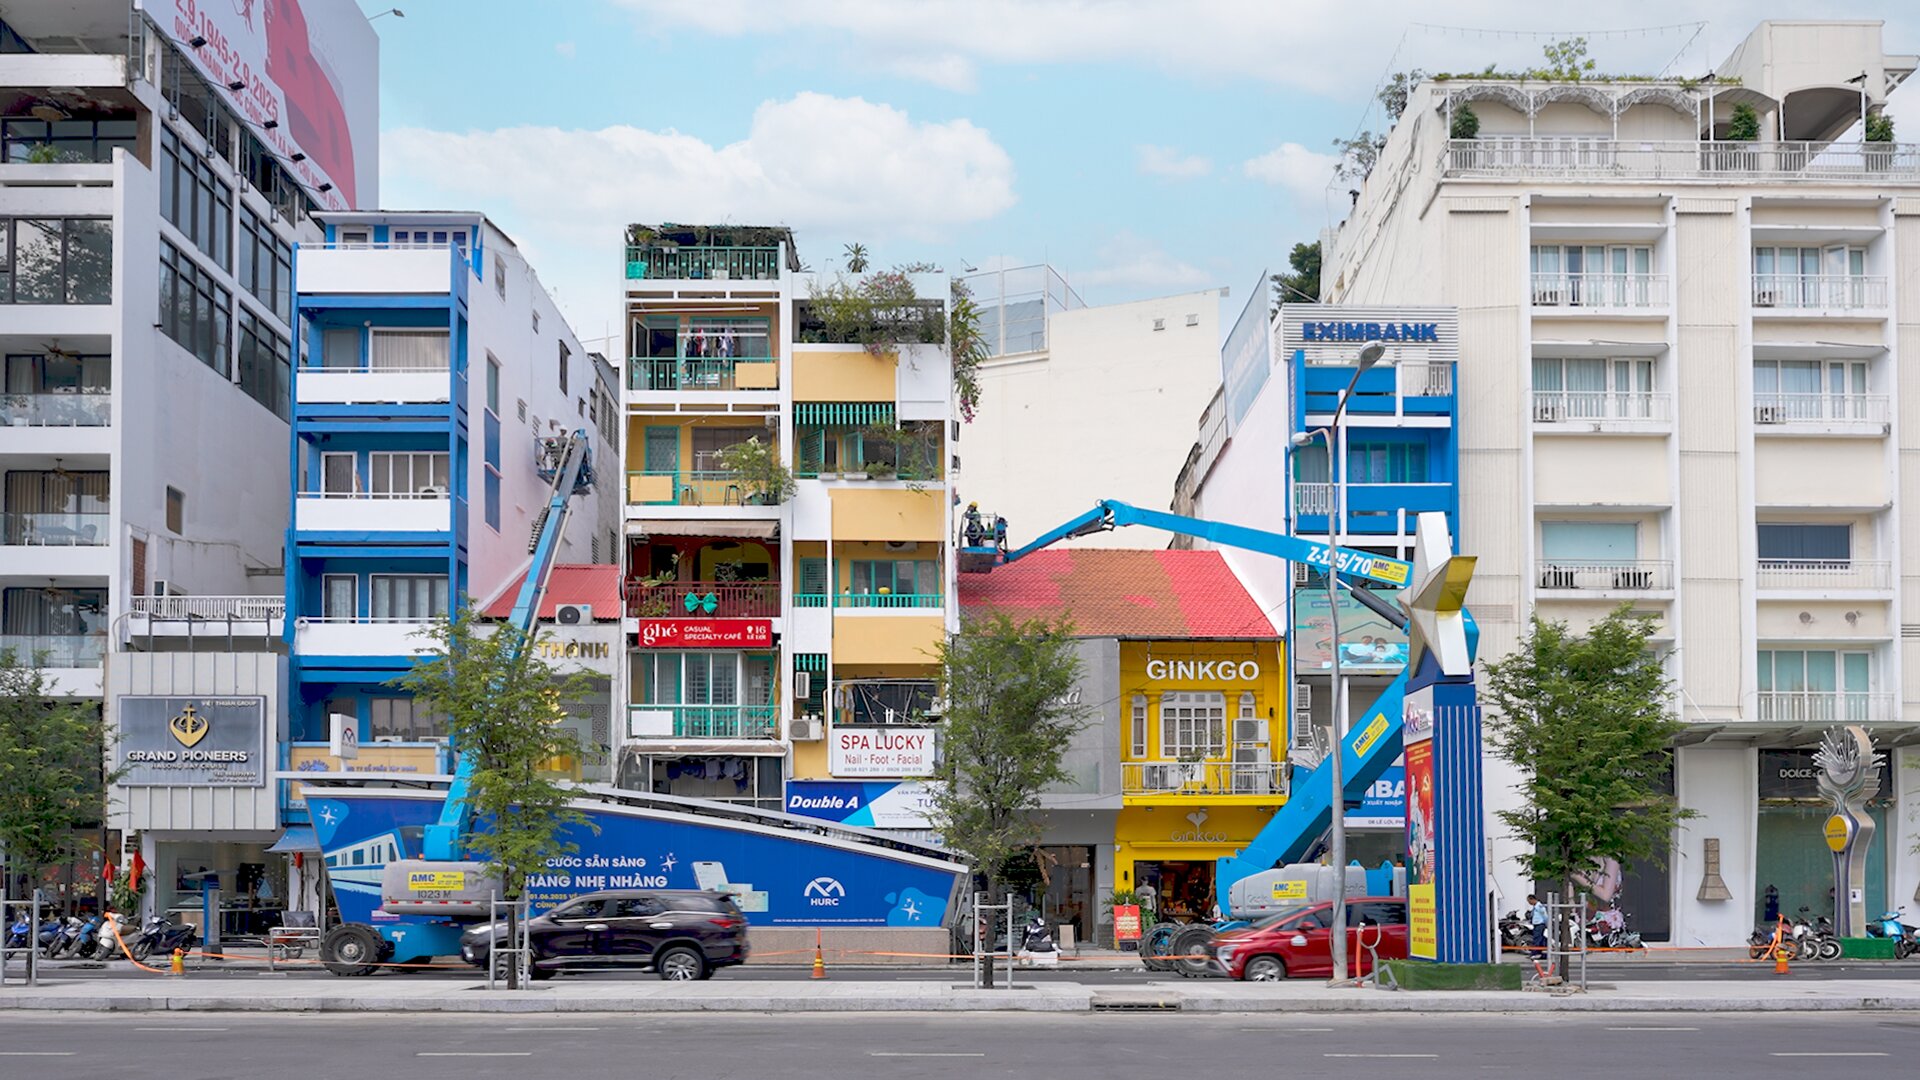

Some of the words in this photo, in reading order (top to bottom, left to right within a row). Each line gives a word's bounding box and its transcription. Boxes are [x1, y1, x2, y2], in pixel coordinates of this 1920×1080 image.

[1303, 322, 1438, 341] EXIMBANK
[1306, 546, 1372, 575] Z-15/70
[1373, 561, 1390, 572] AMC
[724, 632, 742, 640] CAFÉ
[537, 638, 609, 660] THÀNH
[1146, 659, 1260, 681] GINKGO
[841, 735, 870, 750] SPA
[875, 735, 925, 750] LUCKY
[127, 750, 178, 762] GRAND
[181, 750, 248, 762] PIONEERS
[845, 754, 862, 765] Nail
[870, 754, 889, 765] Foot
[897, 754, 923, 765] Facial
[788, 795, 844, 809] Double
[845, 796, 859, 809] A
[585, 854, 609, 868] SẴN
[612, 855, 646, 868] SÀNG
[411, 874, 435, 882] AMC
[575, 875, 606, 890] NHẸ
[610, 873, 668, 888] NHÀNG
[1274, 883, 1289, 891] AMC
[417, 890, 440, 899] 1023
[811, 898, 839, 906] HURC
